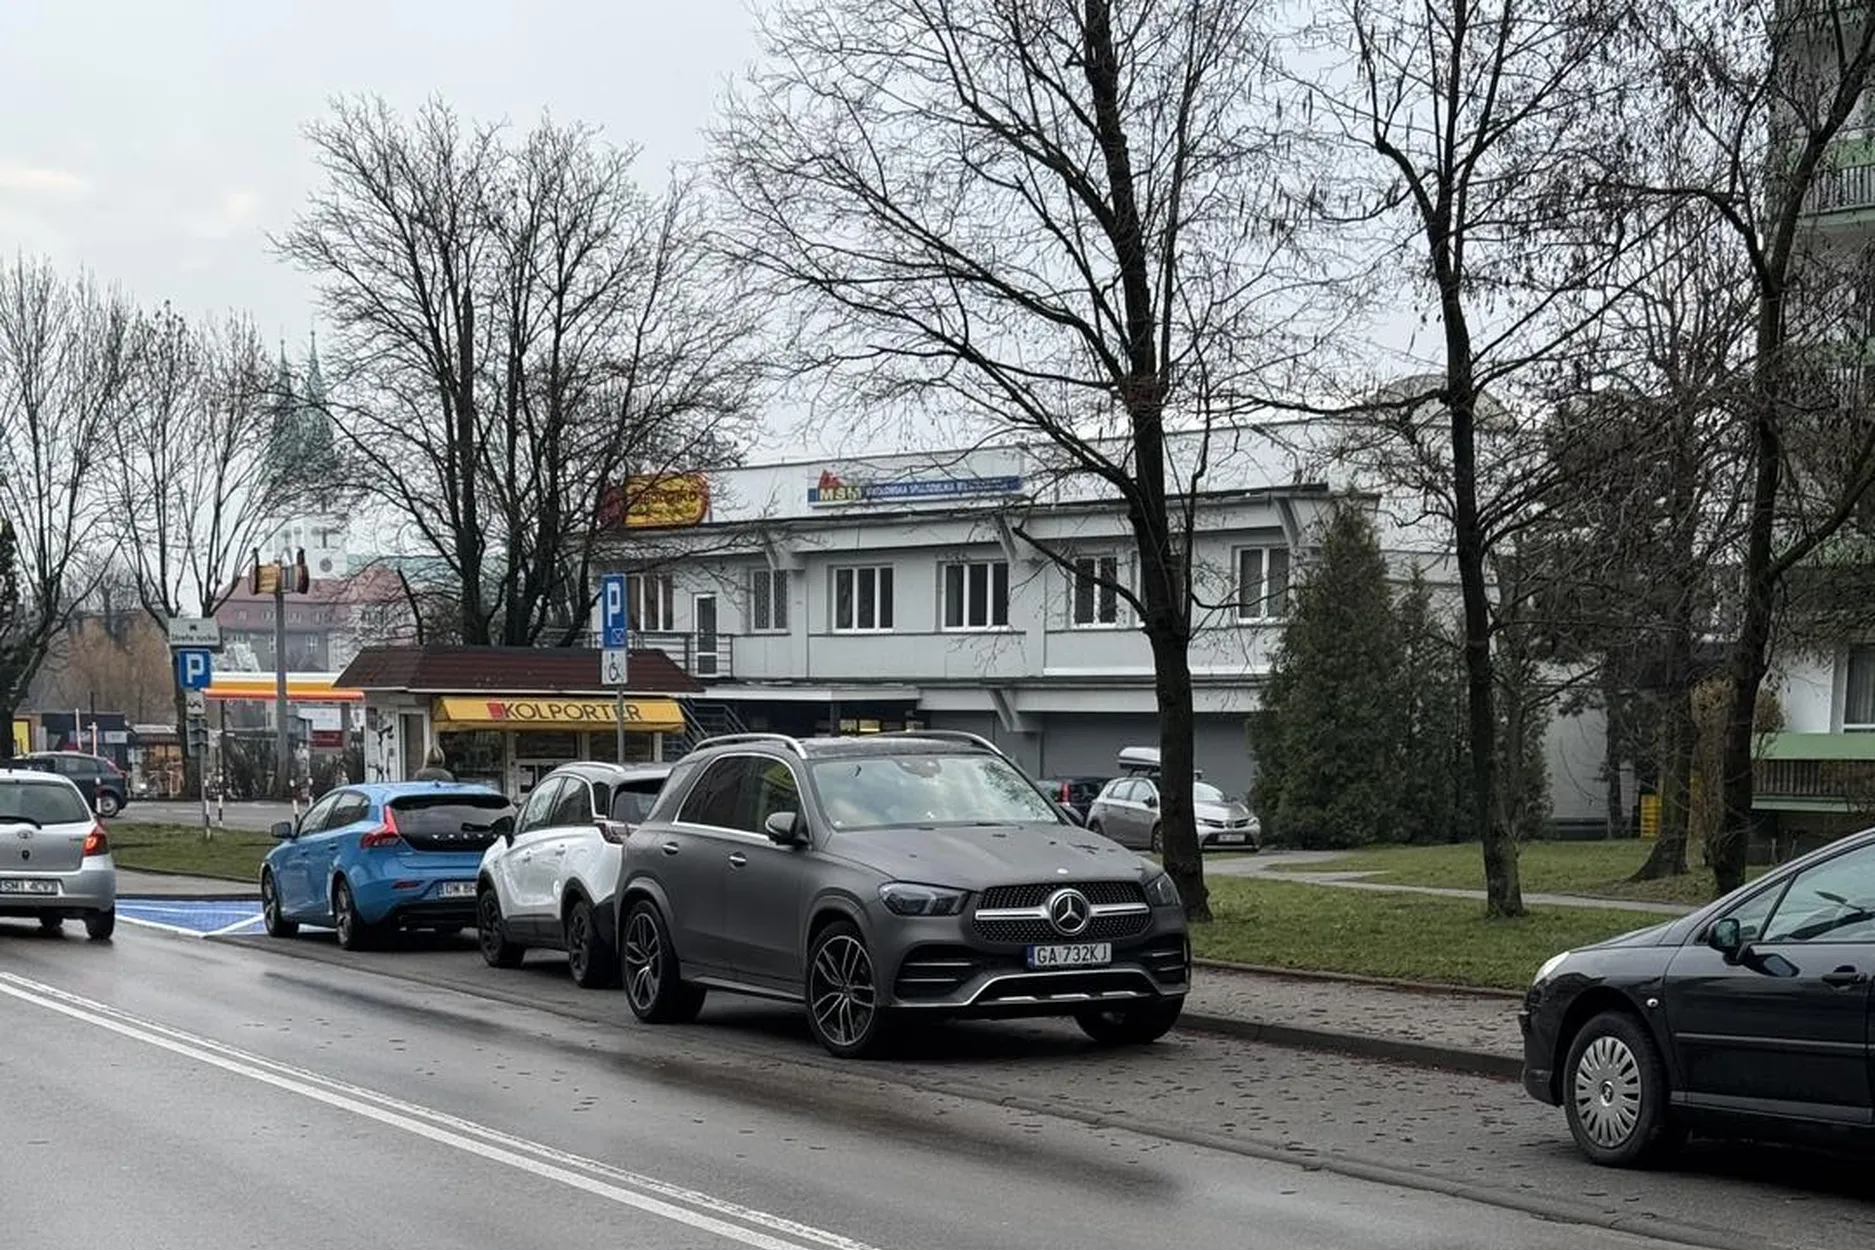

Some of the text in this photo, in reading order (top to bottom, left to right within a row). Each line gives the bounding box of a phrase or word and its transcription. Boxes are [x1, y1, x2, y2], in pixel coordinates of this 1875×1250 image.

[606, 582, 621, 628] P
[186, 653, 204, 684] P
[501, 703, 642, 720] KOLPORTER
[1037, 944, 1108, 964] GA 732KJ
